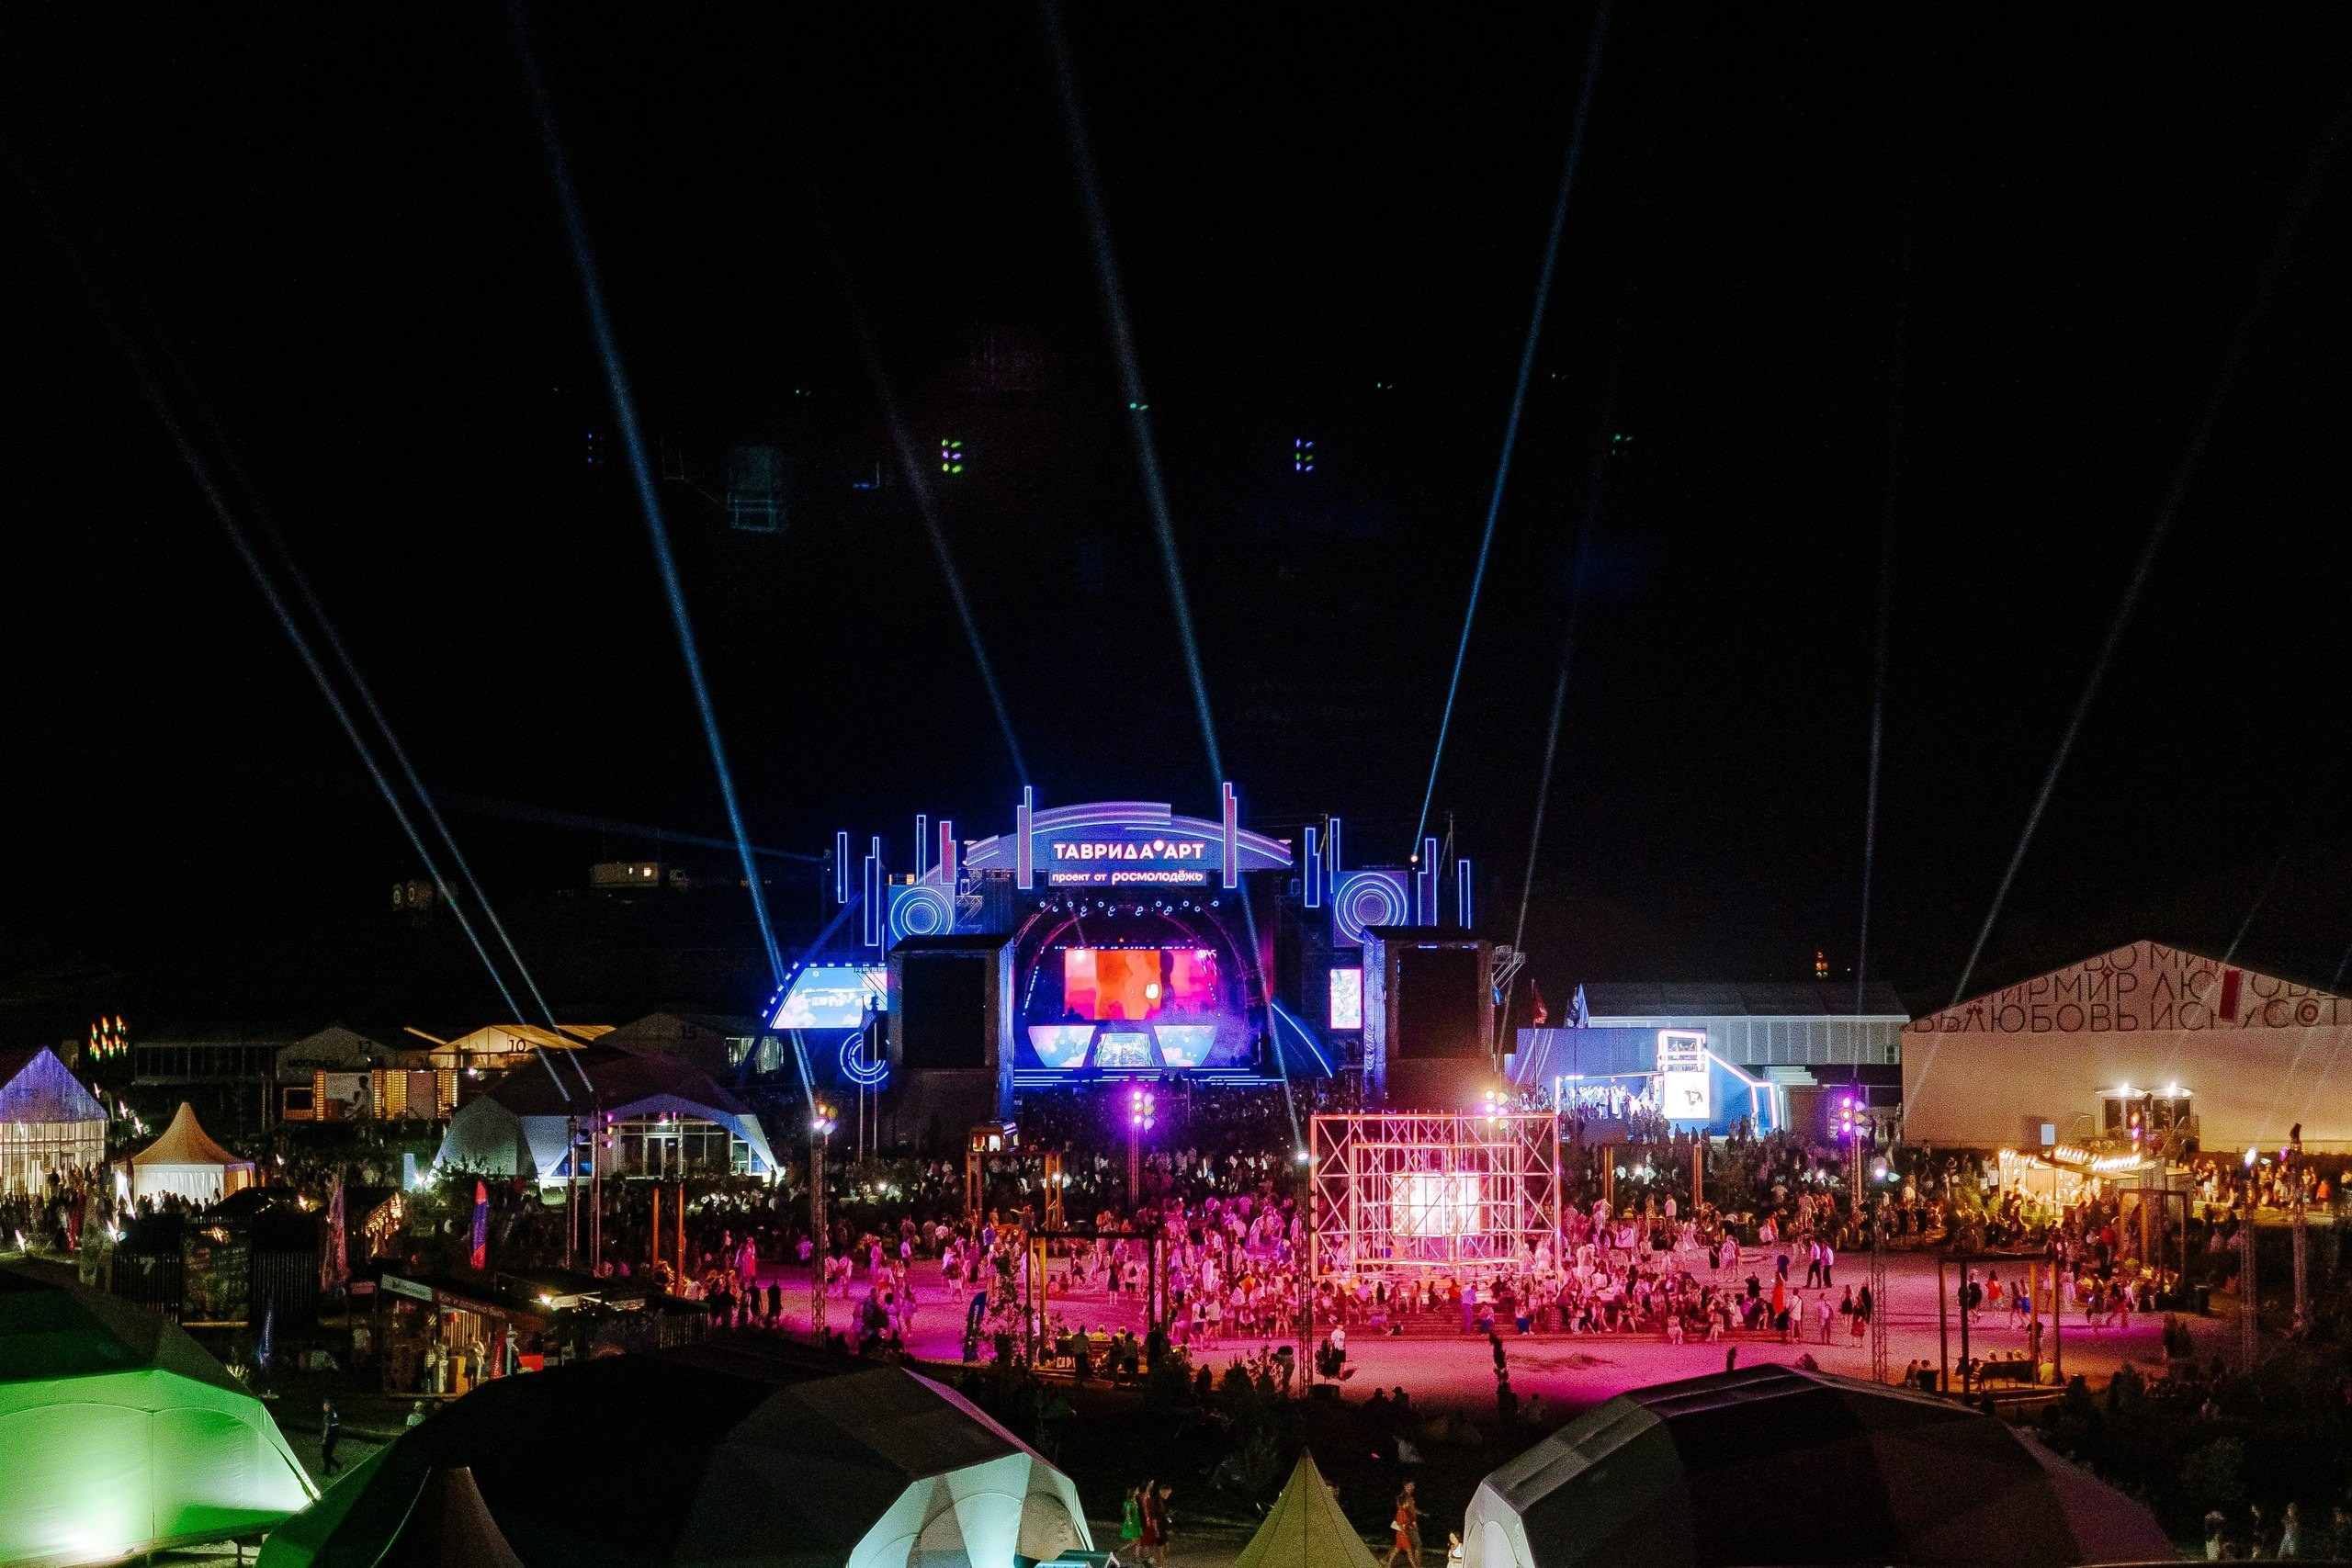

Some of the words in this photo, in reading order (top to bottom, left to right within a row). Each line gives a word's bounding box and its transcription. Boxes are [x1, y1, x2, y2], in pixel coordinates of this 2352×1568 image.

[1052, 873, 1091, 883] проект
[1093, 874, 1107, 882] от
[680, 1025, 697, 1040] 15
[356, 1041, 373, 1054] 12
[509, 1038, 526, 1053] 10
[139, 1257, 156, 1275] 7
